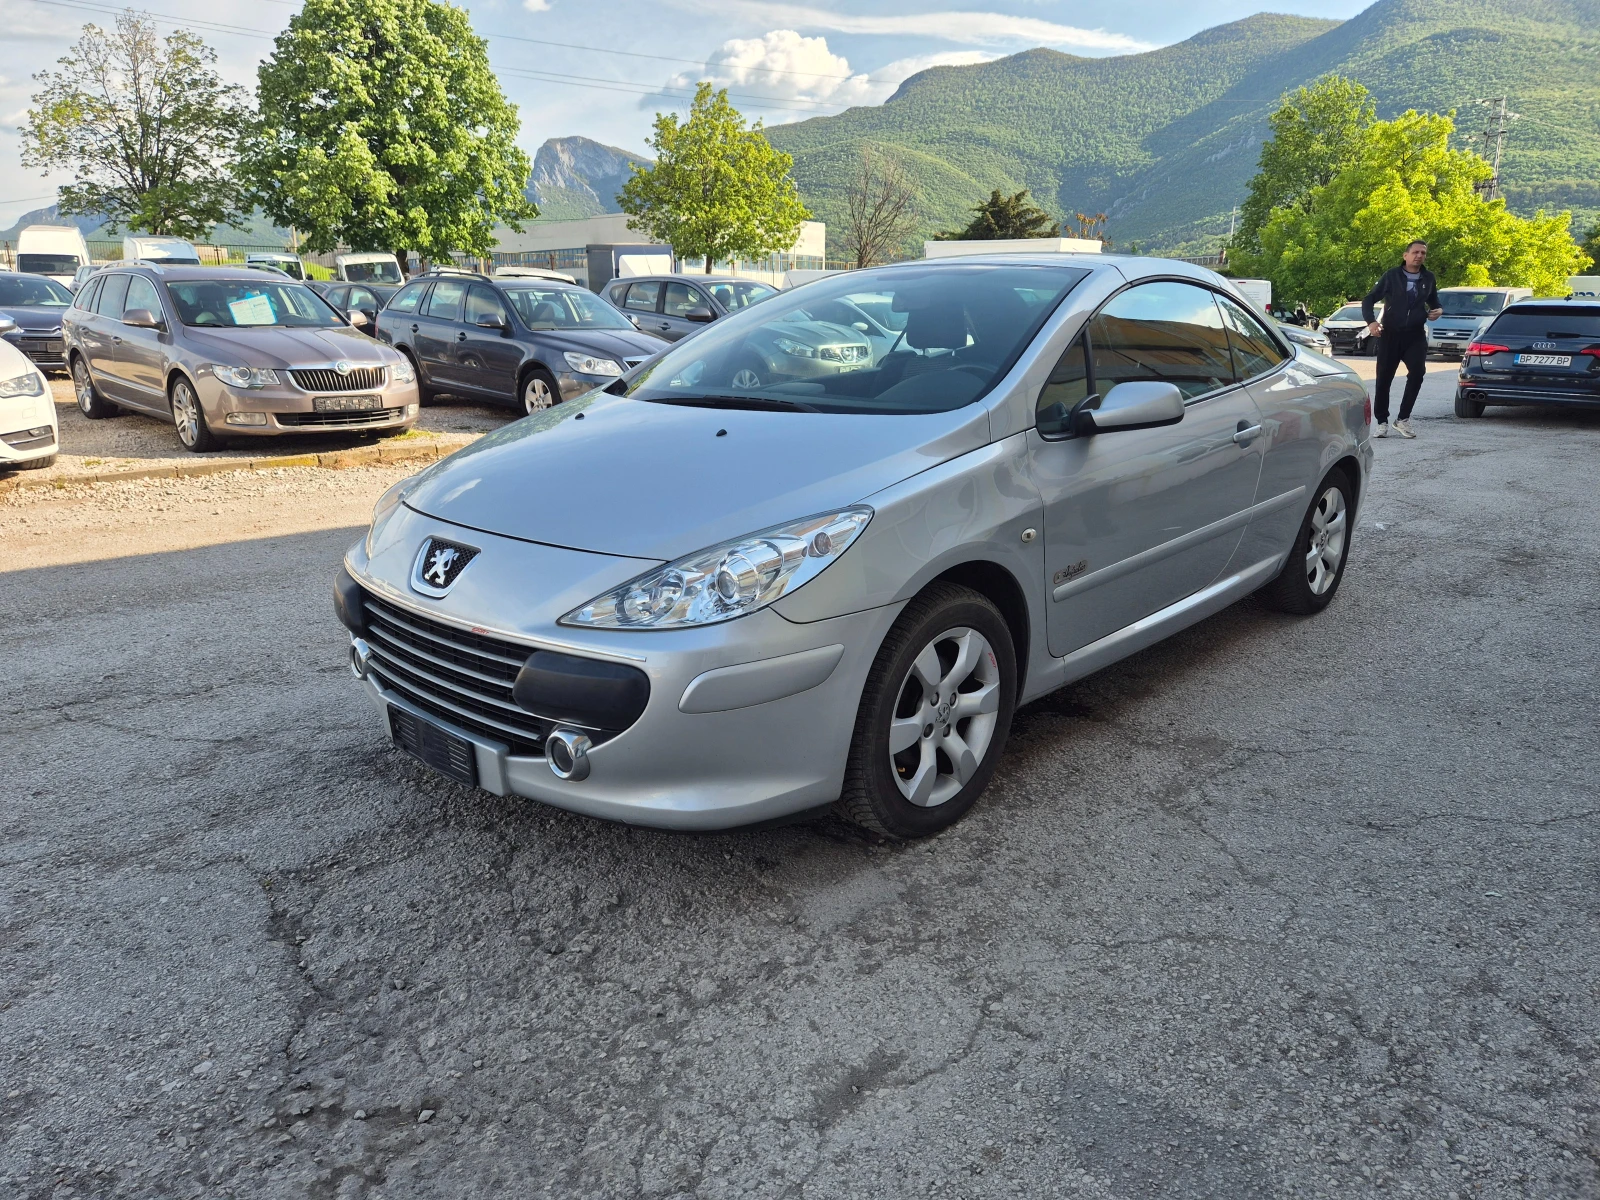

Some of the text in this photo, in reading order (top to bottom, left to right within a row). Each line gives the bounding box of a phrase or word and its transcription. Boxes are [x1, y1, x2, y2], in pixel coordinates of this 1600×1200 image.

[1519, 354, 1570, 366] BP 7277 BP
